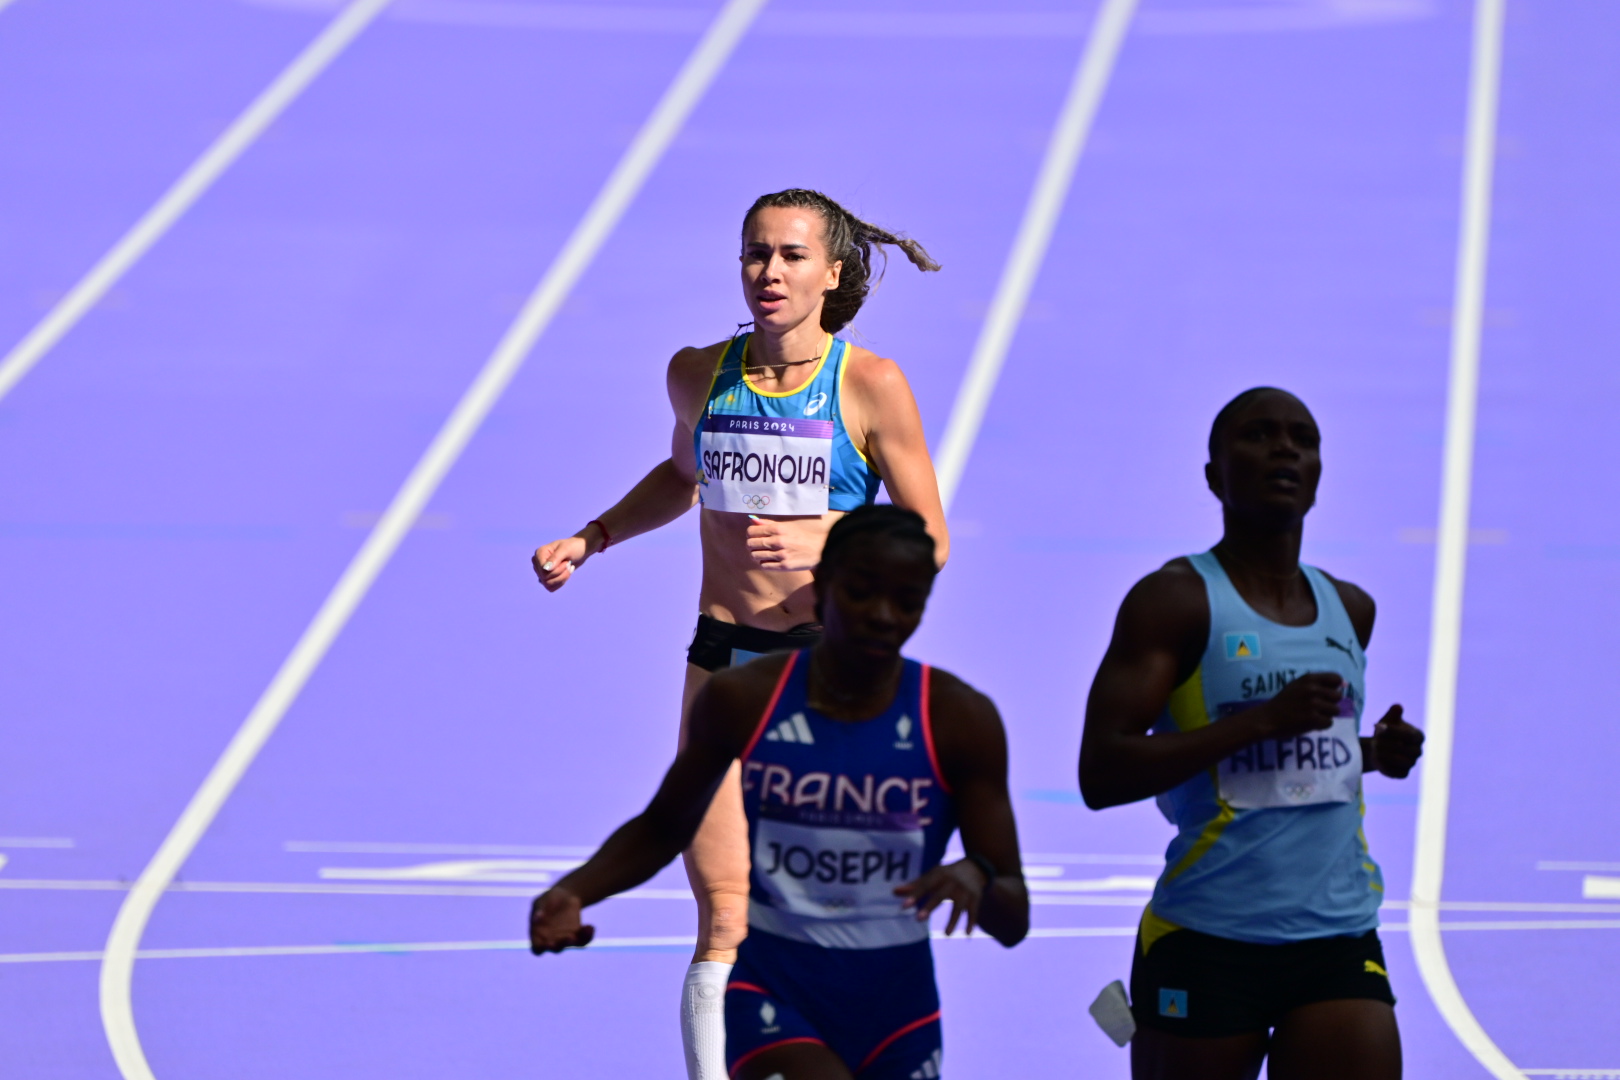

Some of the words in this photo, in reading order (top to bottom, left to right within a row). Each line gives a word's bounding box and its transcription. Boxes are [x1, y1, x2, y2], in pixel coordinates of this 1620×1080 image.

[730, 420, 759, 430] PARIS
[763, 421, 795, 432] 2024
[703, 450, 825, 484] SAFRONOVA
[1232, 737, 1351, 771] ALFRED
[765, 842, 910, 884] JOSEPH
